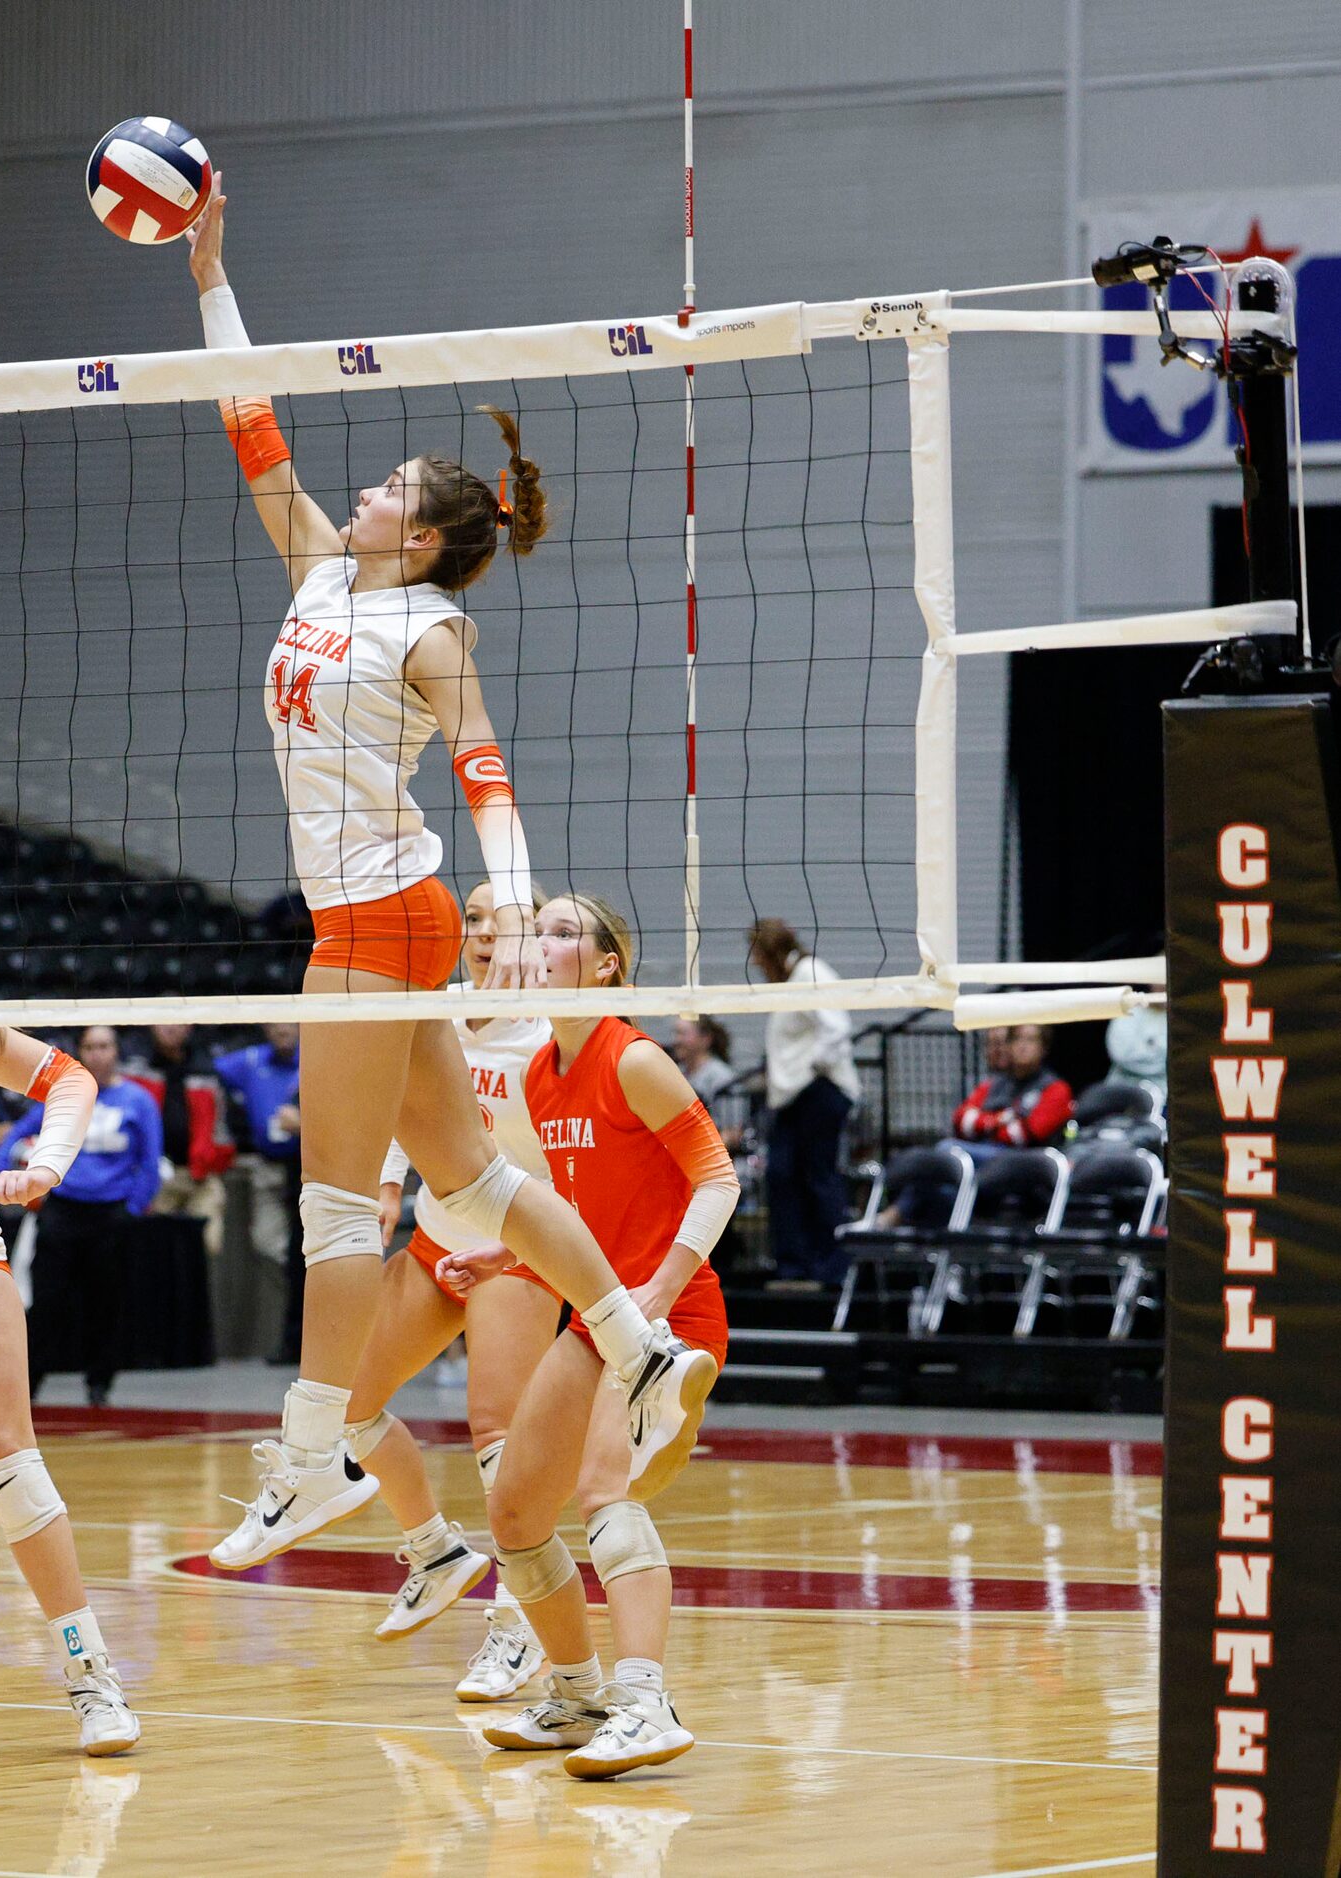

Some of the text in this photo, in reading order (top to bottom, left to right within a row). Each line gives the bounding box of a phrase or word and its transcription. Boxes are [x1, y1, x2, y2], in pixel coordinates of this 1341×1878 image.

[882, 300, 923, 313] Senoh
[696, 320, 756, 337] sports imports
[277, 616, 352, 663] CELINA
[271, 656, 318, 733] 14
[540, 1117, 595, 1151] CELINA
[1211, 822, 1286, 1852] CULWELL CENTER
